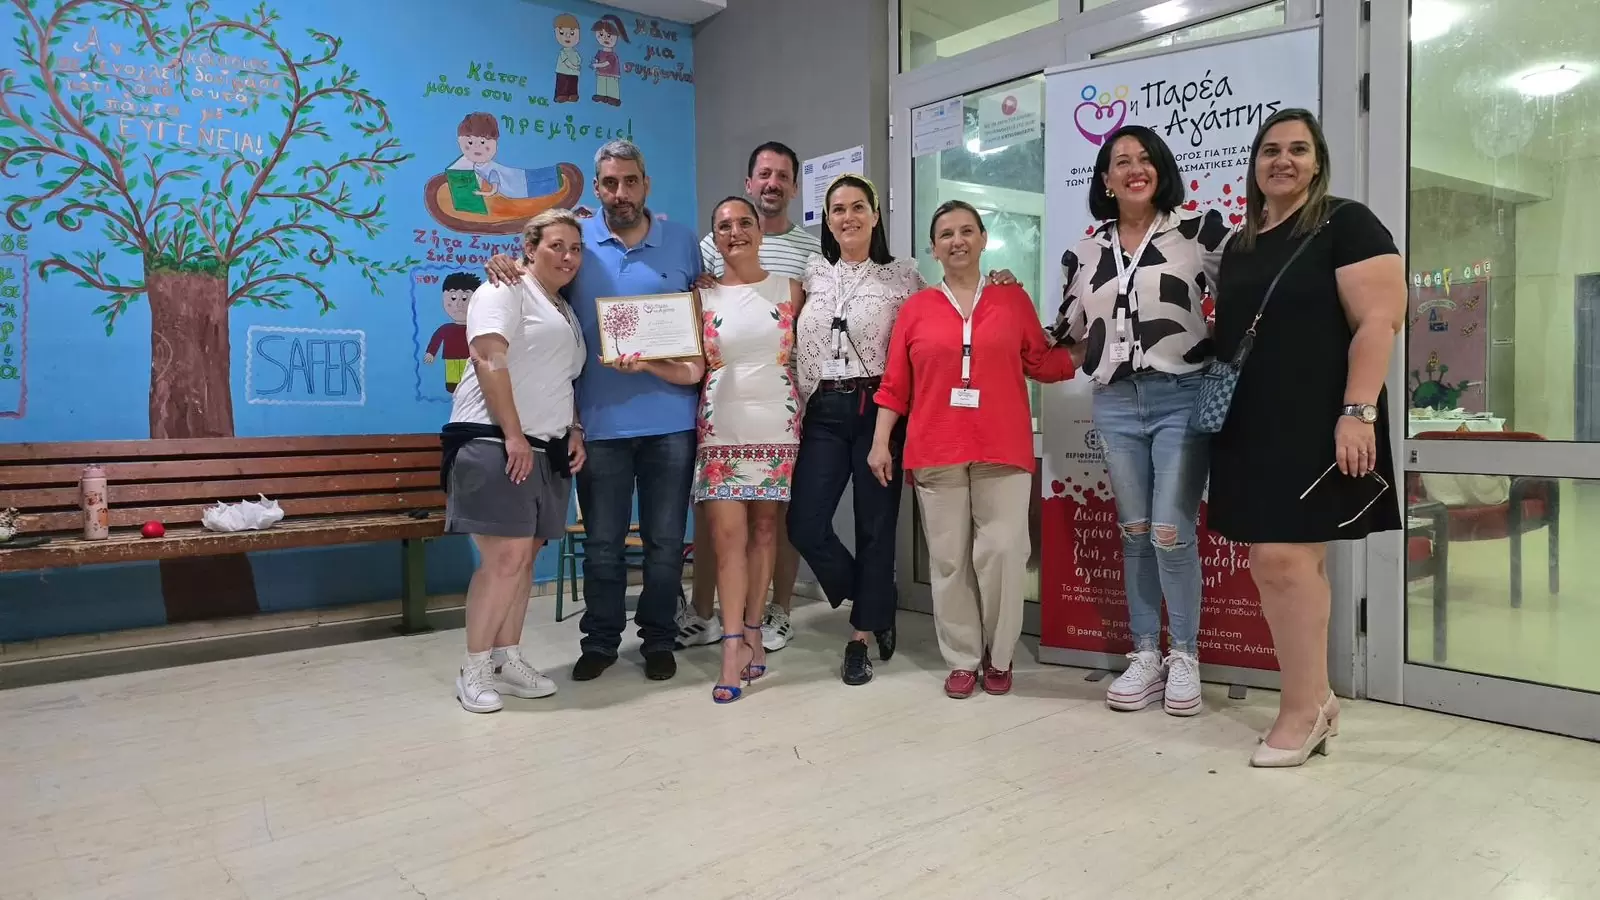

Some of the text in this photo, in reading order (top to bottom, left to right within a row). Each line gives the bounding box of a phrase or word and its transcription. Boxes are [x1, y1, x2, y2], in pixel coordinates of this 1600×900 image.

[643, 43, 675, 61] μια
[467, 60, 528, 87] Κάτσε
[423, 74, 550, 108] μόνος σου να
[1130, 69, 1233, 116] η Παρέα
[120, 116, 263, 155] ΕΥΓΕΝΕΙΑ!
[501, 114, 633, 143] ηρεμήσεις!
[1164, 100, 1282, 147] Αγάπης
[1175, 150, 1202, 161] ΟΓΟΣ
[1204, 149, 1220, 158] ΓΙΑ
[1222, 146, 1238, 156] ΤΙΣ
[1065, 178, 1084, 187] ΤΩΝ
[1178, 160, 1233, 173] ΑΣΜΑΤΙΚΕΣ
[413, 229, 462, 248] Ζήτα
[426, 247, 488, 266] Σκέψου
[256, 335, 362, 396] SAFER
[1074, 526, 1113, 545] χρόνο
[1073, 541, 1106, 565] ζωή,
[1200, 548, 1250, 576] οδοξία
[1061, 583, 1071, 592] Το
[1075, 565, 1121, 584] αγάπη
[1196, 639, 1221, 650] αρέα
[1243, 643, 1277, 657] Αγάπη
